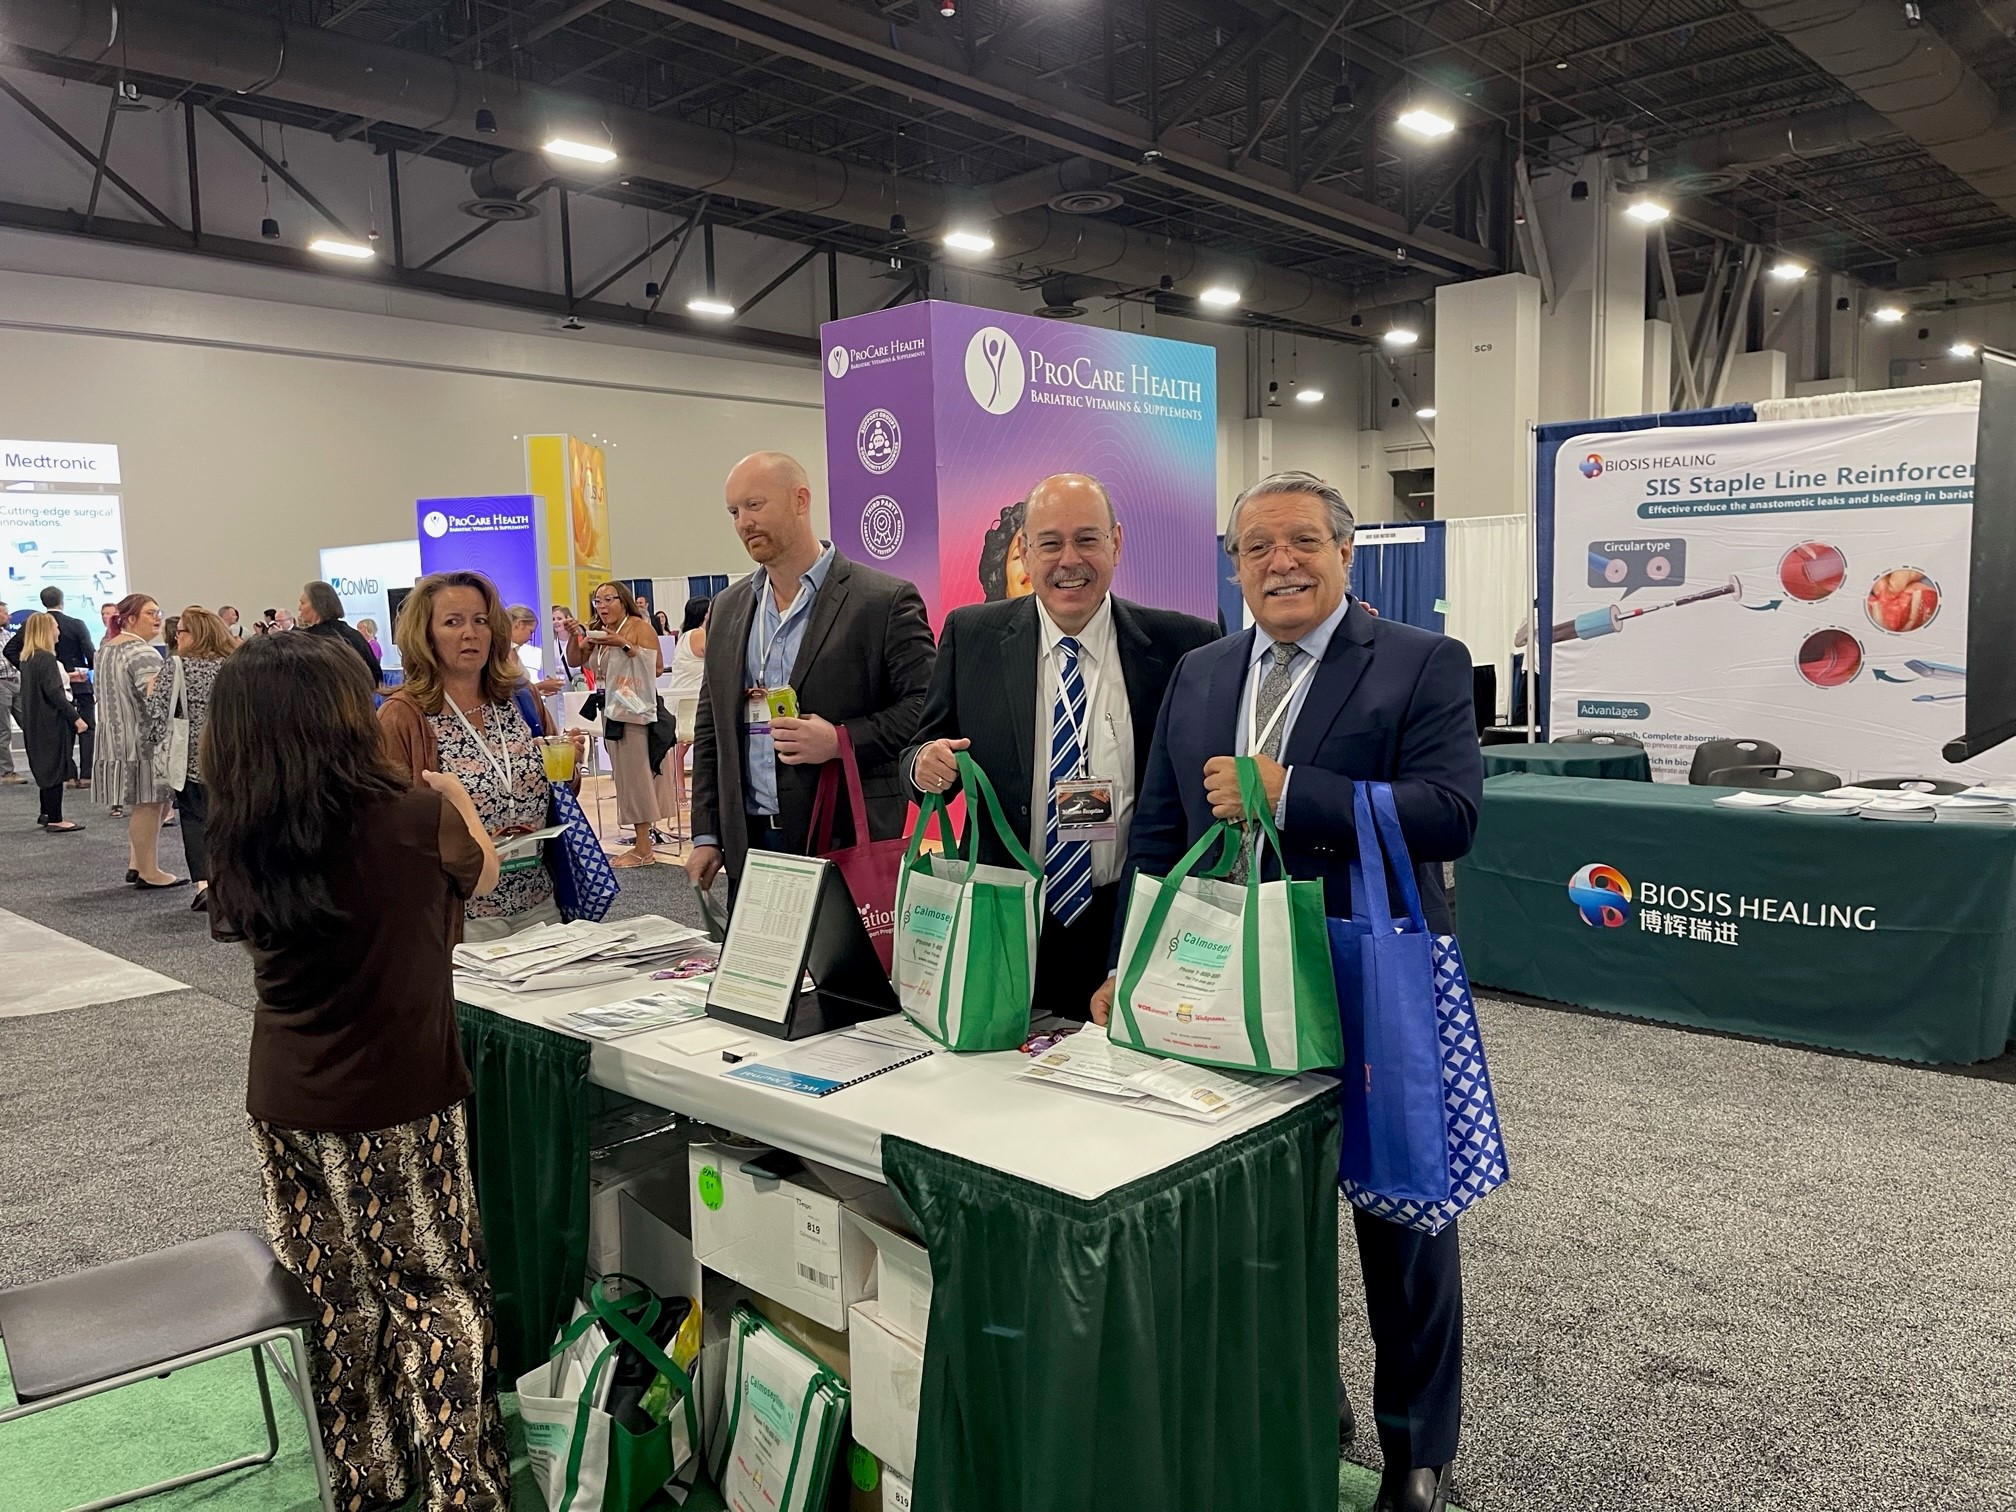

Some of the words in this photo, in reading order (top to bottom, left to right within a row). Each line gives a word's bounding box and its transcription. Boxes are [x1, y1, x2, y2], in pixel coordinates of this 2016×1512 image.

[1474, 343, 1493, 353] SC9
[1133, 400, 1141, 413] &
[5, 453, 97, 471] Medtronic
[1605, 457, 1650, 472] BIOSIS
[1652, 453, 1716, 469] HEALING
[1646, 478, 1681, 496] SIS
[1689, 472, 1766, 497] Staple
[1775, 469, 1827, 489] Line
[1648, 505, 1691, 515] Effective
[1693, 502, 1727, 513] reduce
[1730, 500, 1748, 511] the
[1750, 496, 1815, 510] anastomotic
[1817, 495, 1845, 506] leaks
[1849, 492, 1869, 505] and
[1872, 491, 1922, 504] bleeding
[1925, 490, 1936, 500] in
[73, 507, 113, 519] surgical
[1604, 541, 1645, 553] Circular
[1647, 542, 1671, 555] type
[1580, 704, 1639, 719] Advantages
[1642, 731, 1684, 743] Complete
[1653, 742, 1679, 751] prevent
[1665, 757, 1673, 766] in
[1640, 881, 1732, 916] BIOSIS
[1739, 895, 1877, 931] HEALING
[1639, 908, 1739, 946] 博辉瑞进
[807, 1221, 820, 1235] 819
[895, 1492, 909, 1508] 819
